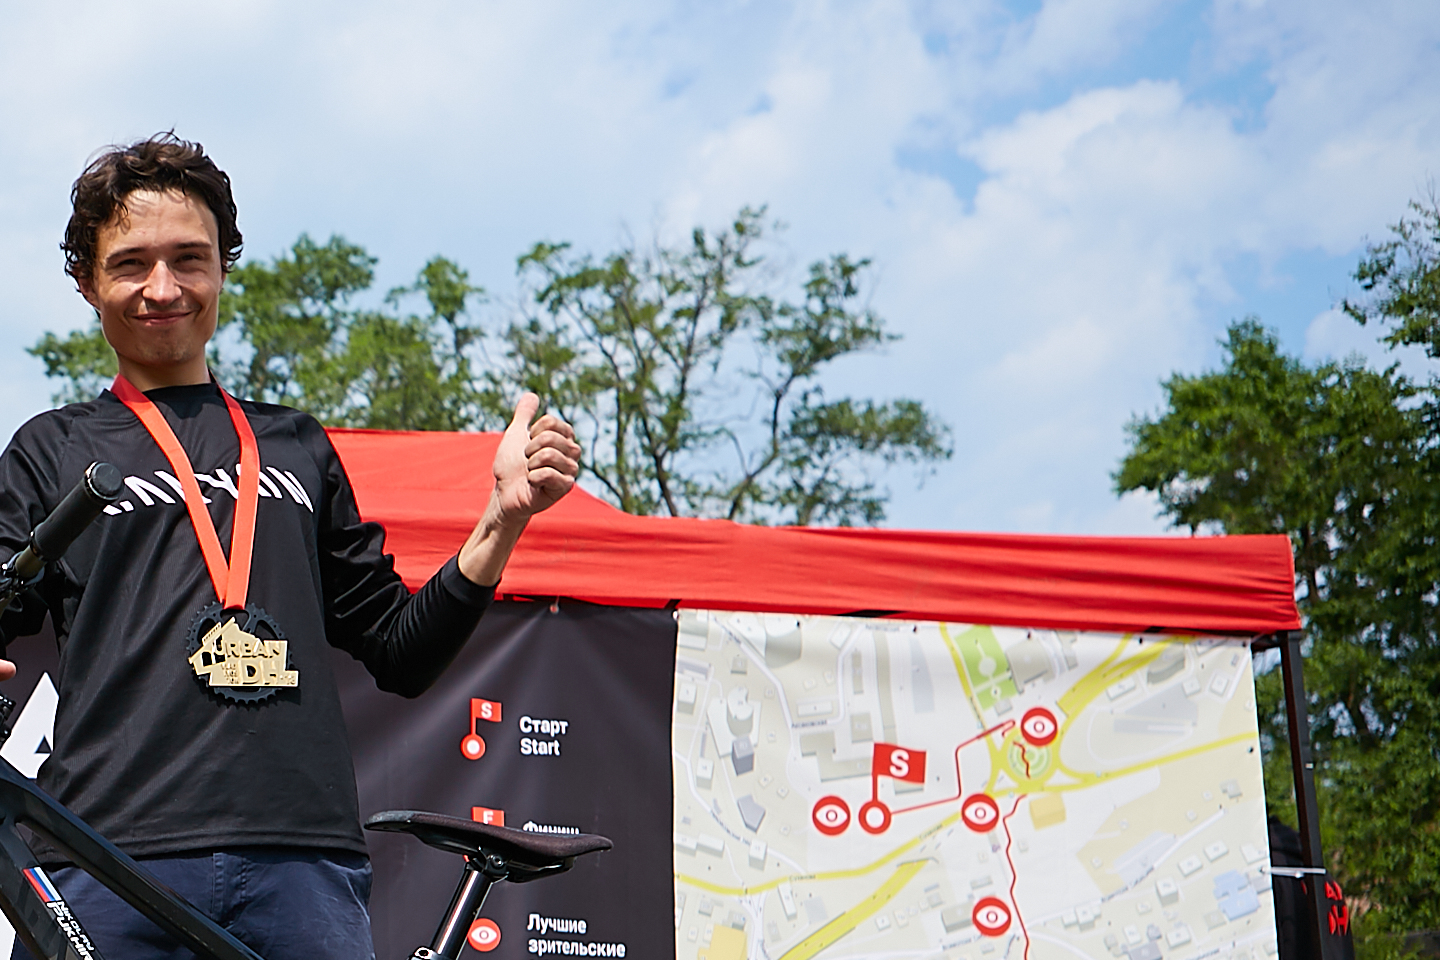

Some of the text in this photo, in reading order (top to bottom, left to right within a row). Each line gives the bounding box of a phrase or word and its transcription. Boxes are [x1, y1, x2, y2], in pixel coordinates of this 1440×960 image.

[518, 716, 569, 738] Старт
[520, 738, 561, 756] Start
[527, 913, 588, 934] Лучшие
[528, 938, 627, 958] зрительские
